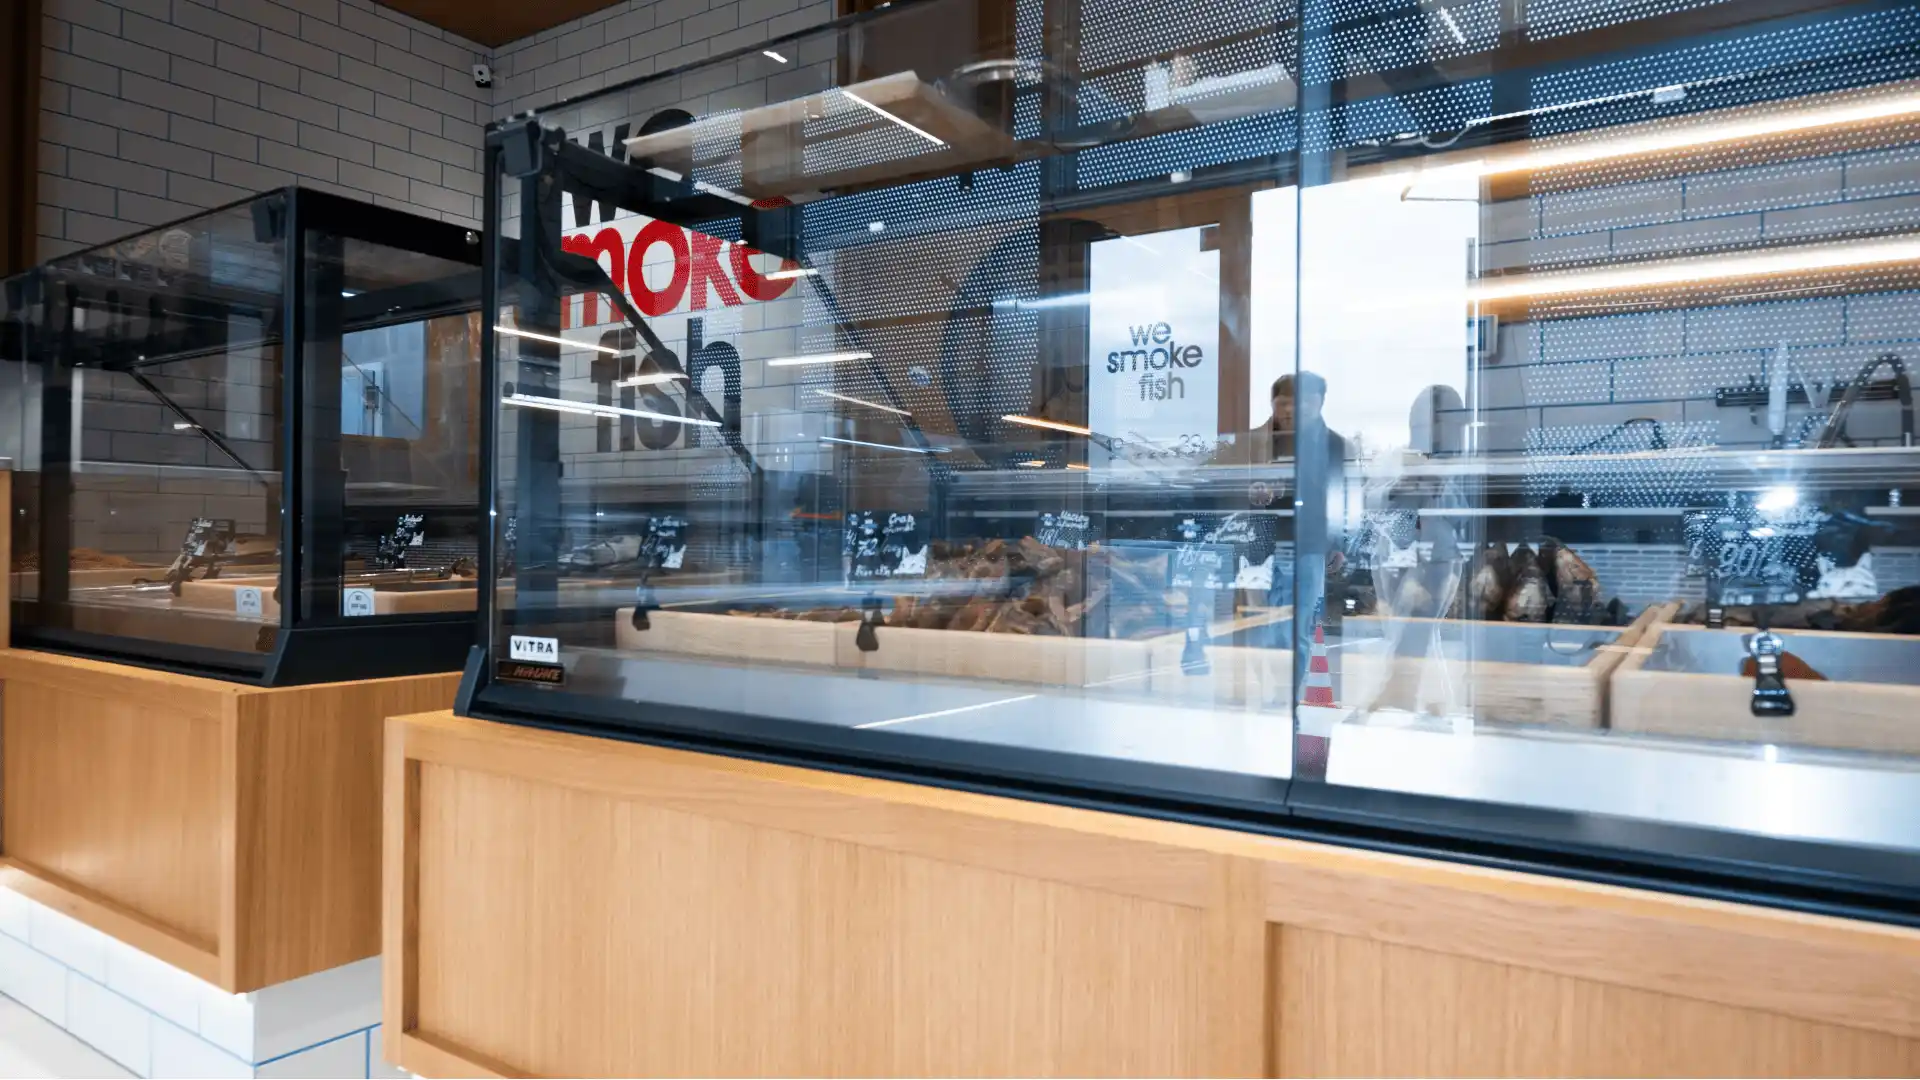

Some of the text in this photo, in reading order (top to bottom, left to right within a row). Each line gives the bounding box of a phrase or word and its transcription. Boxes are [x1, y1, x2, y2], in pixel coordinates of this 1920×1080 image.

[561, 196, 798, 331] moke
[1130, 322, 1172, 346] we
[1107, 342, 1203, 373] smoke
[590, 318, 742, 453] fish
[1139, 372, 1184, 400] fish
